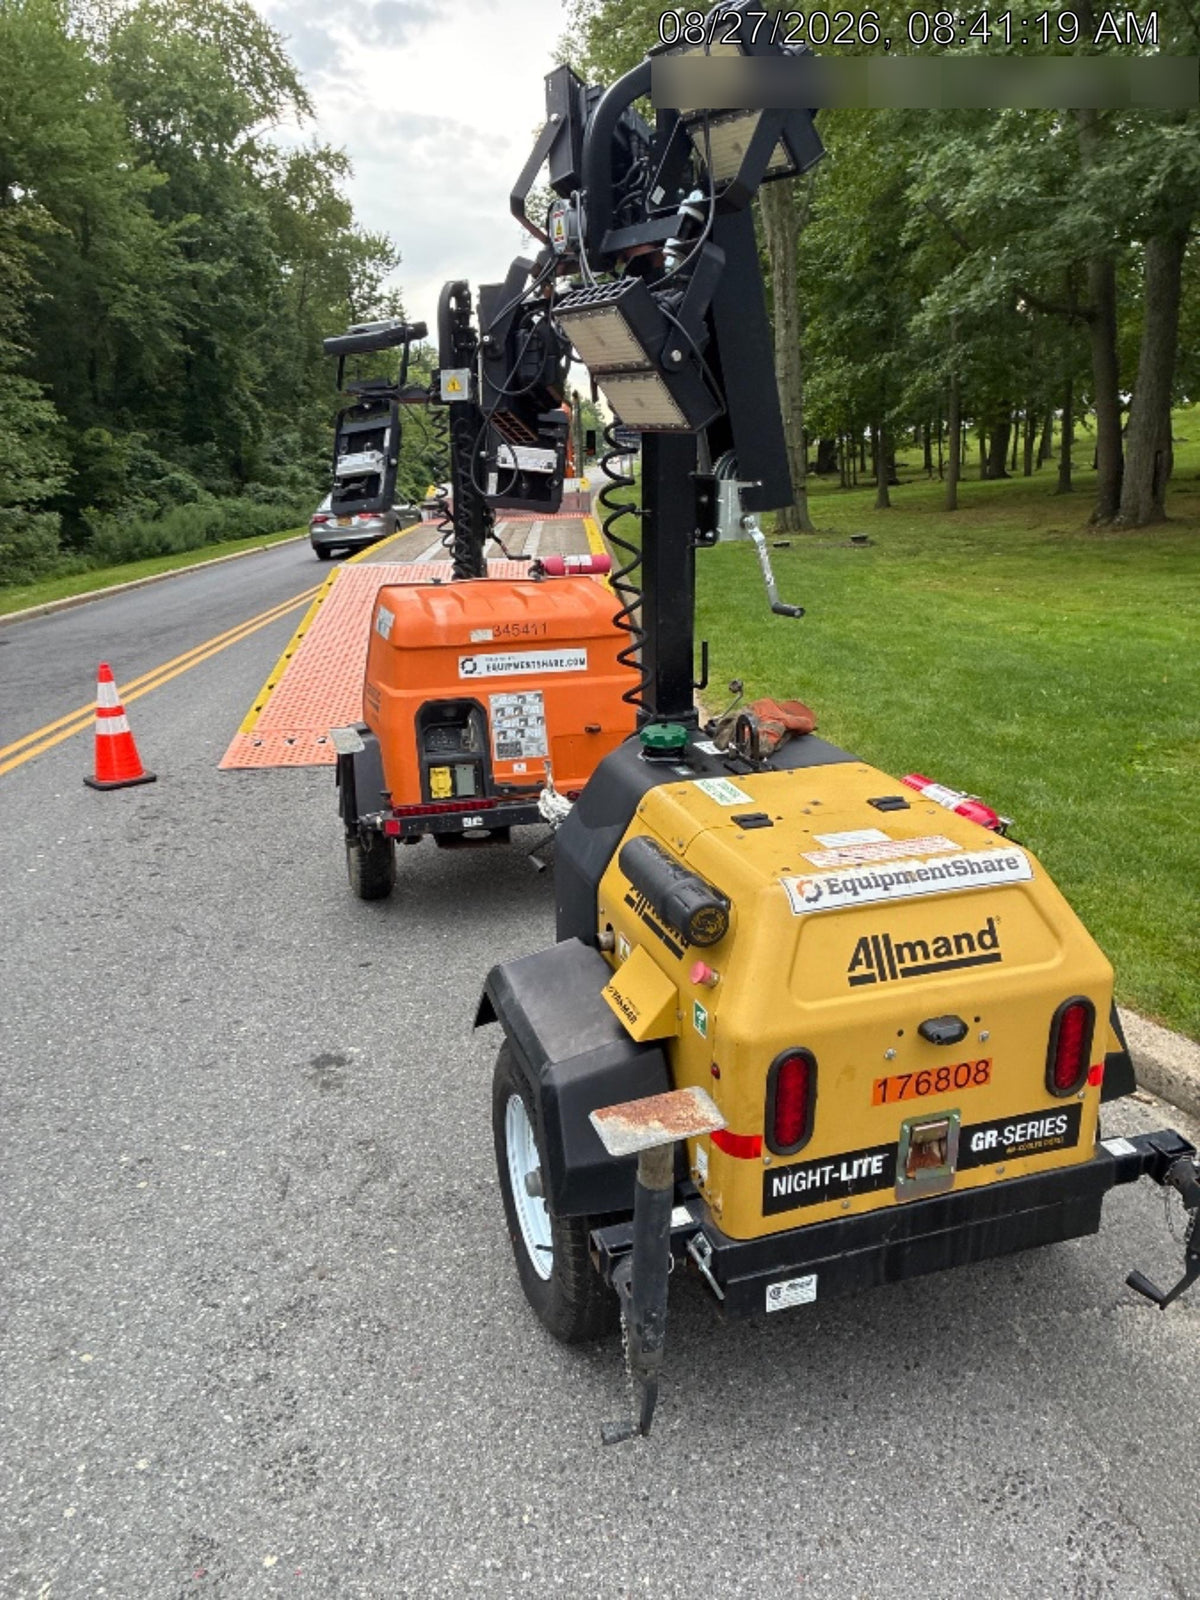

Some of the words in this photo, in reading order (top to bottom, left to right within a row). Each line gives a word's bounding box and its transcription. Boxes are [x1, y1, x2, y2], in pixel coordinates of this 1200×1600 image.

[492, 622, 548, 638] 345411
[486, 657, 587, 673] EQUIPMENTSHARE.COM
[823, 855, 1020, 896] EquipmentShare
[847, 916, 1001, 982] Allmand
[877, 1059, 990, 1103] 176808
[970, 1114, 1068, 1152] GR-SERIES
[772, 1155, 884, 1197] NIGHT-LITE
